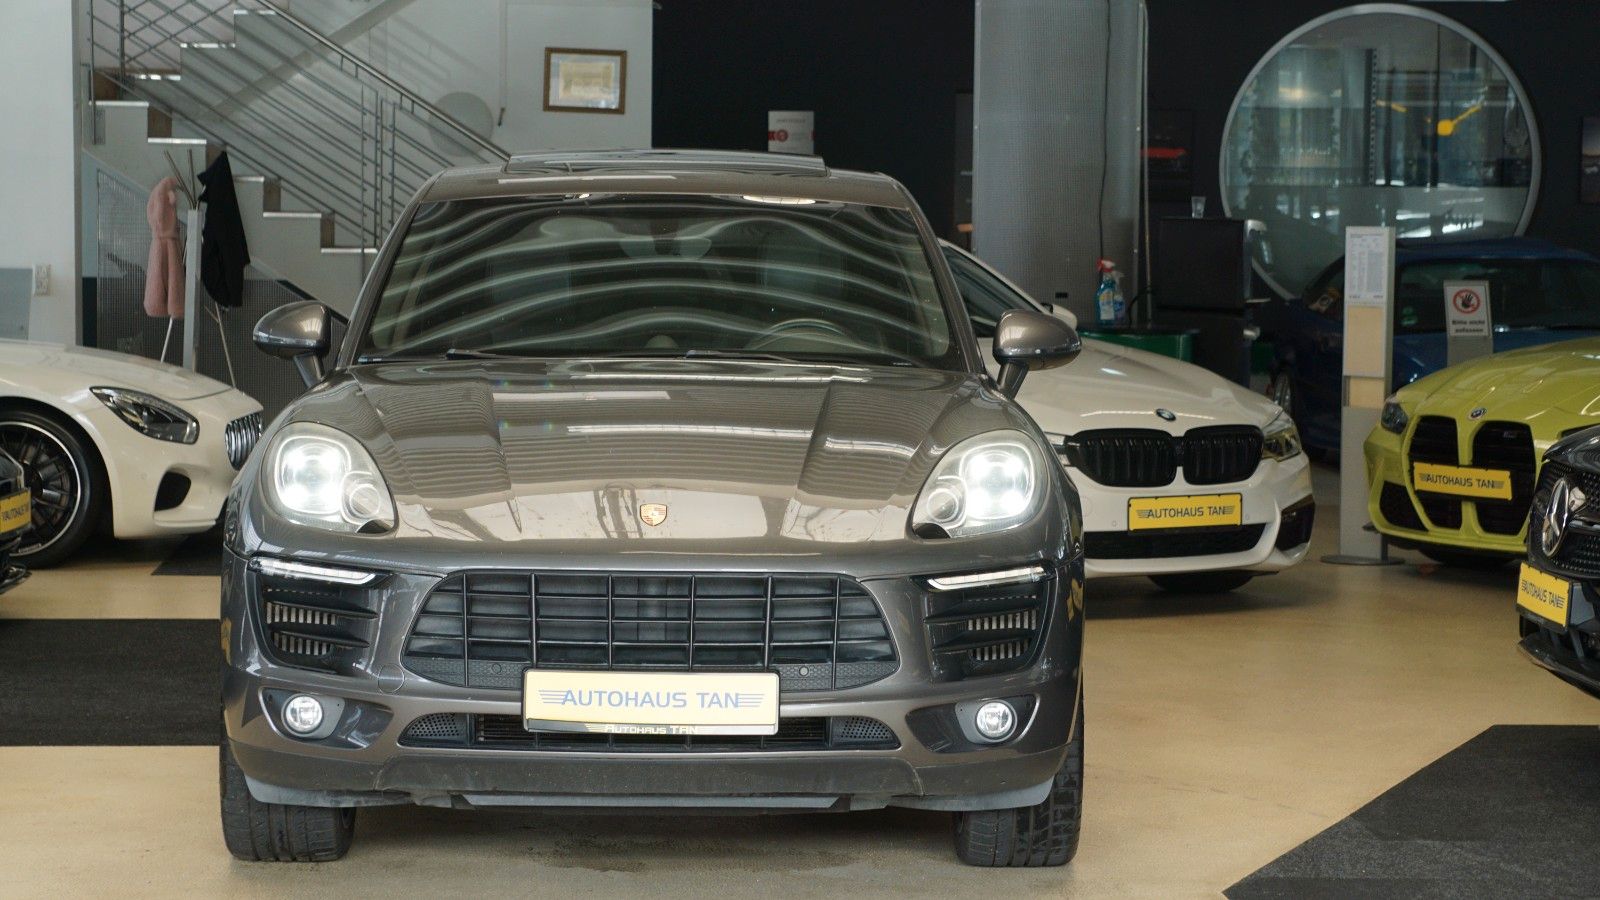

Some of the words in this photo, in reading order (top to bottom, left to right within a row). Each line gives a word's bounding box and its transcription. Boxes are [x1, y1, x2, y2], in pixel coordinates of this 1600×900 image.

[1426, 474, 1473, 487] AUTOHAUS
[1476, 478, 1495, 489] TAN
[1147, 507, 1204, 518] AUTOHAUS
[1208, 506, 1225, 516] TAN
[561, 689, 687, 708] AUTOHAUS
[696, 691, 740, 708] TAN
[605, 724, 667, 735] AUTOHAUS
[669, 725, 700, 735] TAN
